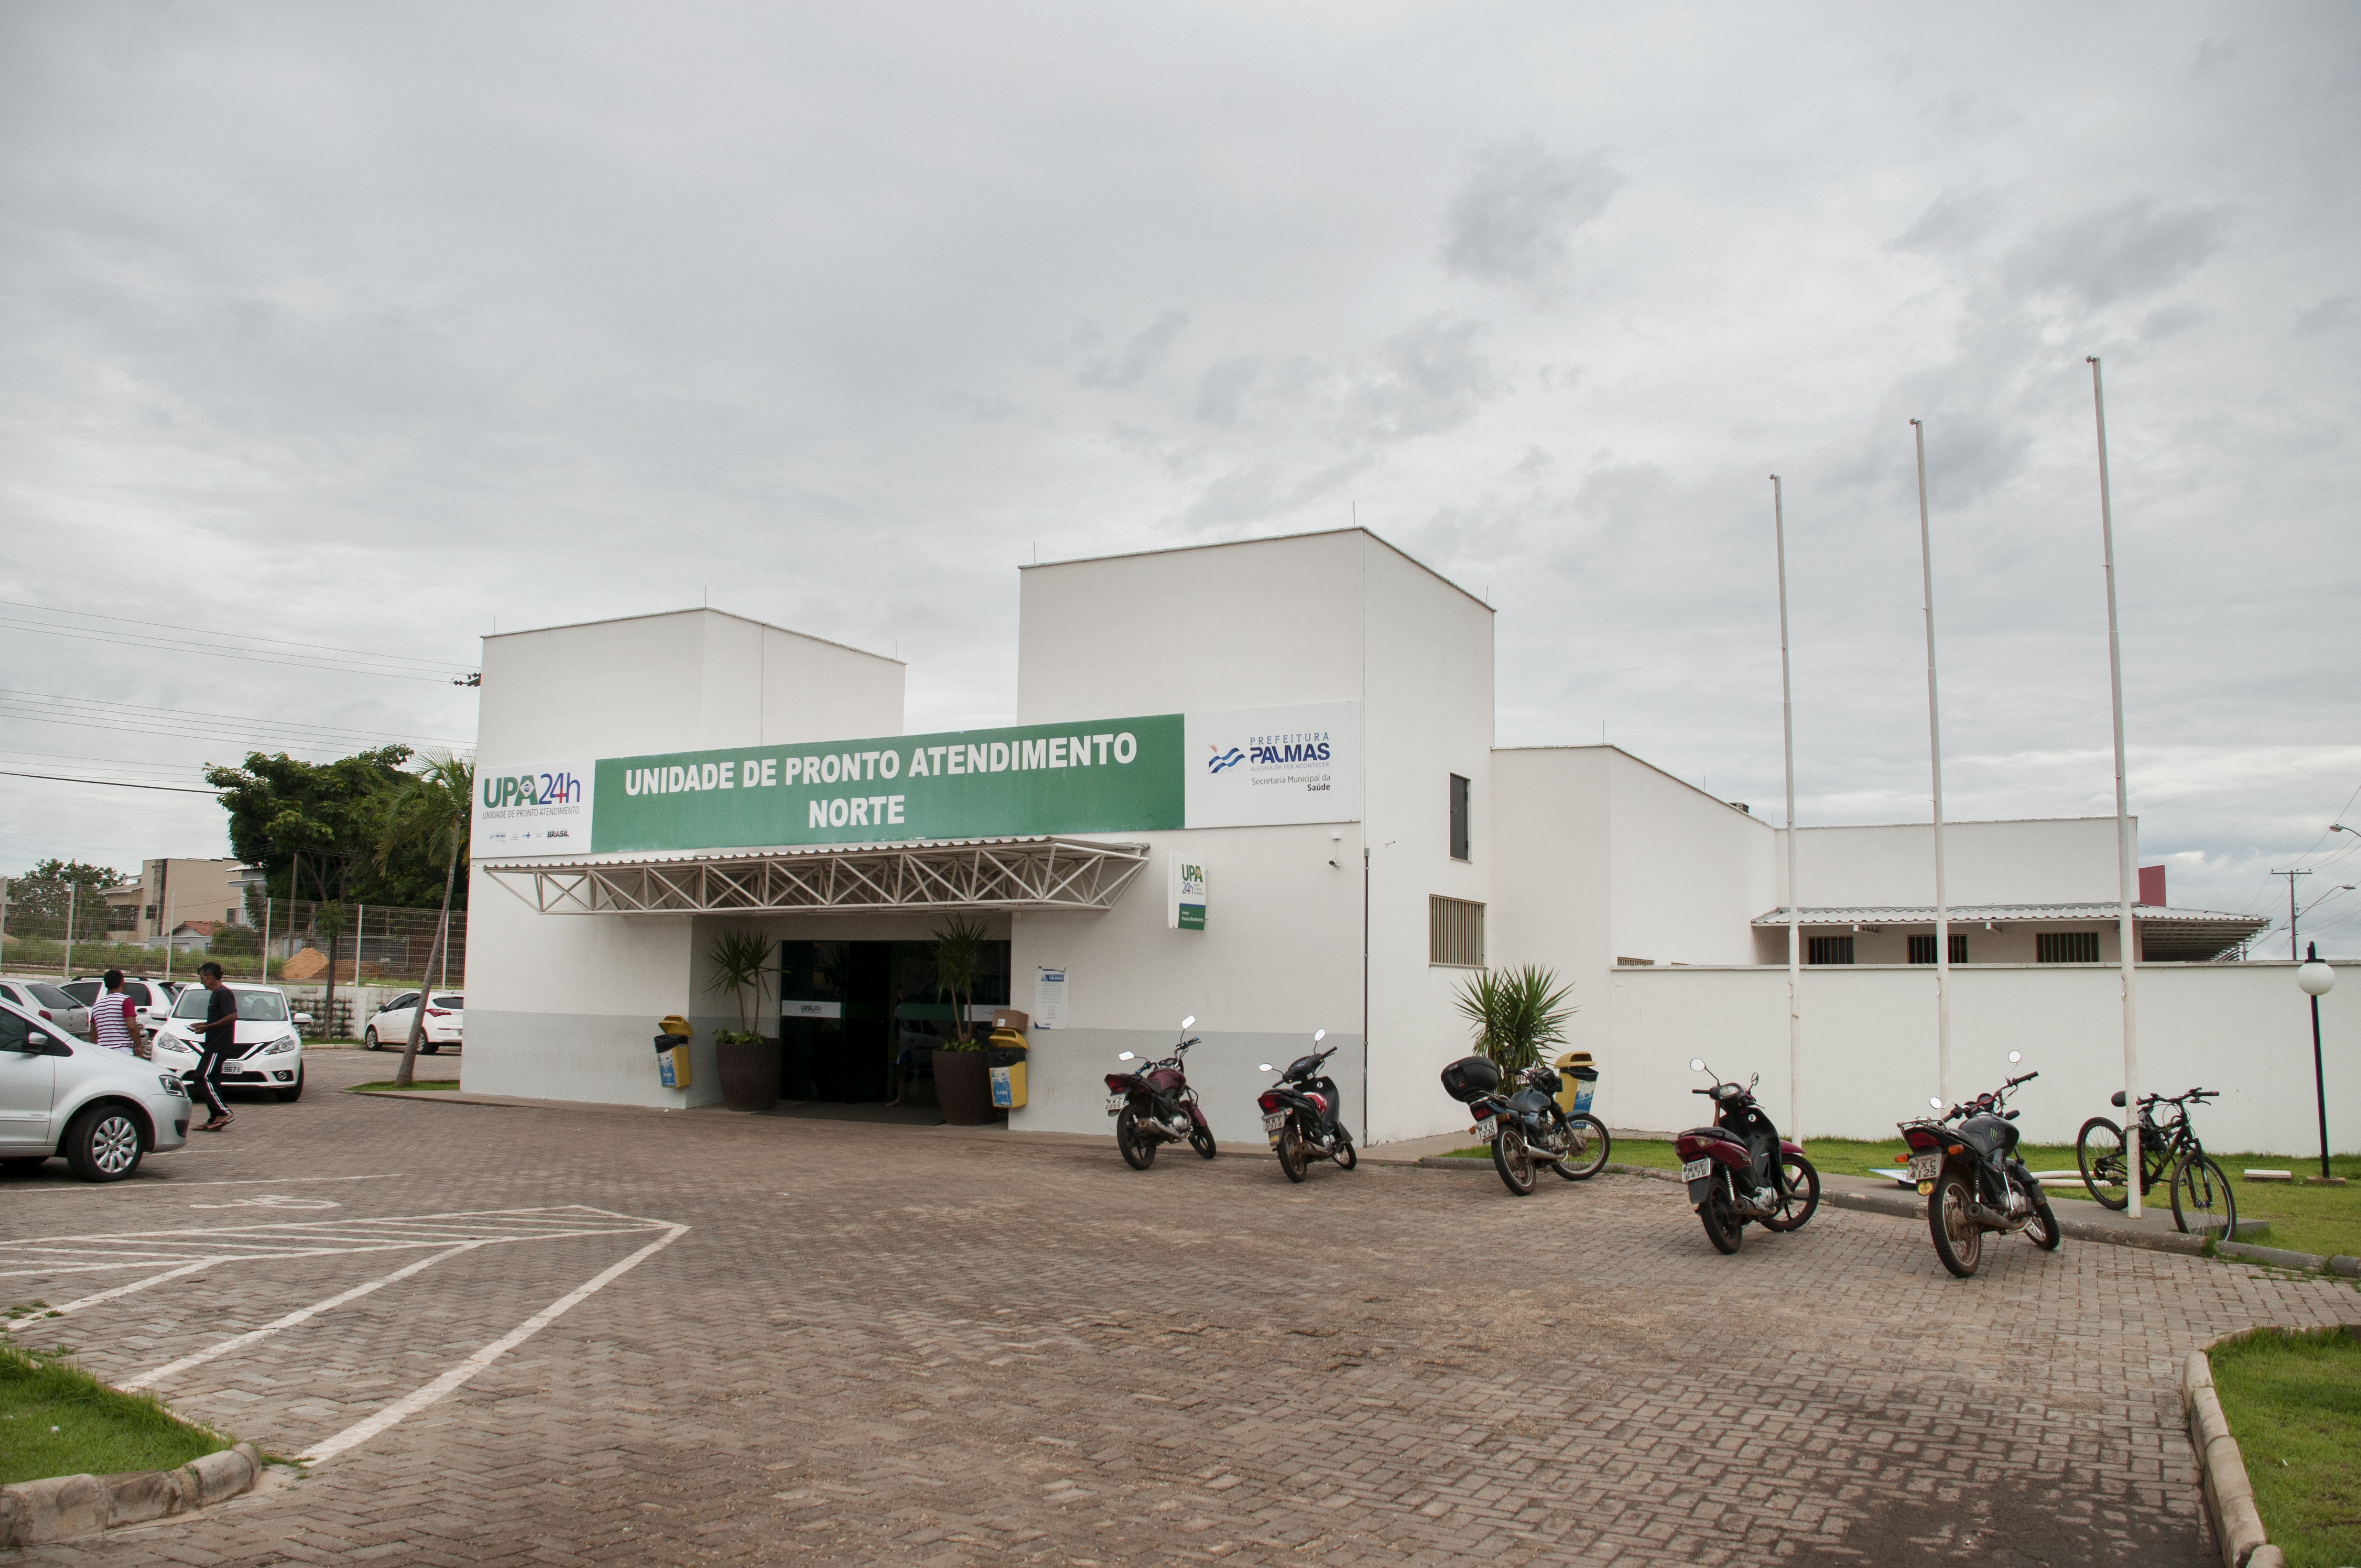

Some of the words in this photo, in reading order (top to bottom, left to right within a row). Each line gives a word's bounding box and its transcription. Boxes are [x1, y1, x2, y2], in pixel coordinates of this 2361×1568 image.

[1250, 732, 1329, 745] PREFEITURA
[1250, 743, 1330, 764] PALMAS
[625, 761, 735, 796] UNIDADE
[743, 759, 777, 788] DE
[785, 750, 900, 786] PRONTO
[908, 732, 1137, 777] ATENDIMENTO
[1252, 776, 1286, 785] Secretaria
[1288, 774, 1320, 783] Municipal
[1307, 783, 1330, 791] Saúde
[482, 810, 507, 819] UNIDADE
[508, 810, 515, 818] DE
[516, 808, 538, 818] PRONTO
[539, 806, 580, 816] ATENDIMENTO
[809, 795, 905, 828] NORTE
[1182, 864, 1203, 883] UPA
[1182, 881, 1193, 894] 24h
[1479, 1126, 1495, 1139] 1230
[1911, 1159, 1936, 1170] MXC
[1909, 1168, 1936, 1178] 4125
